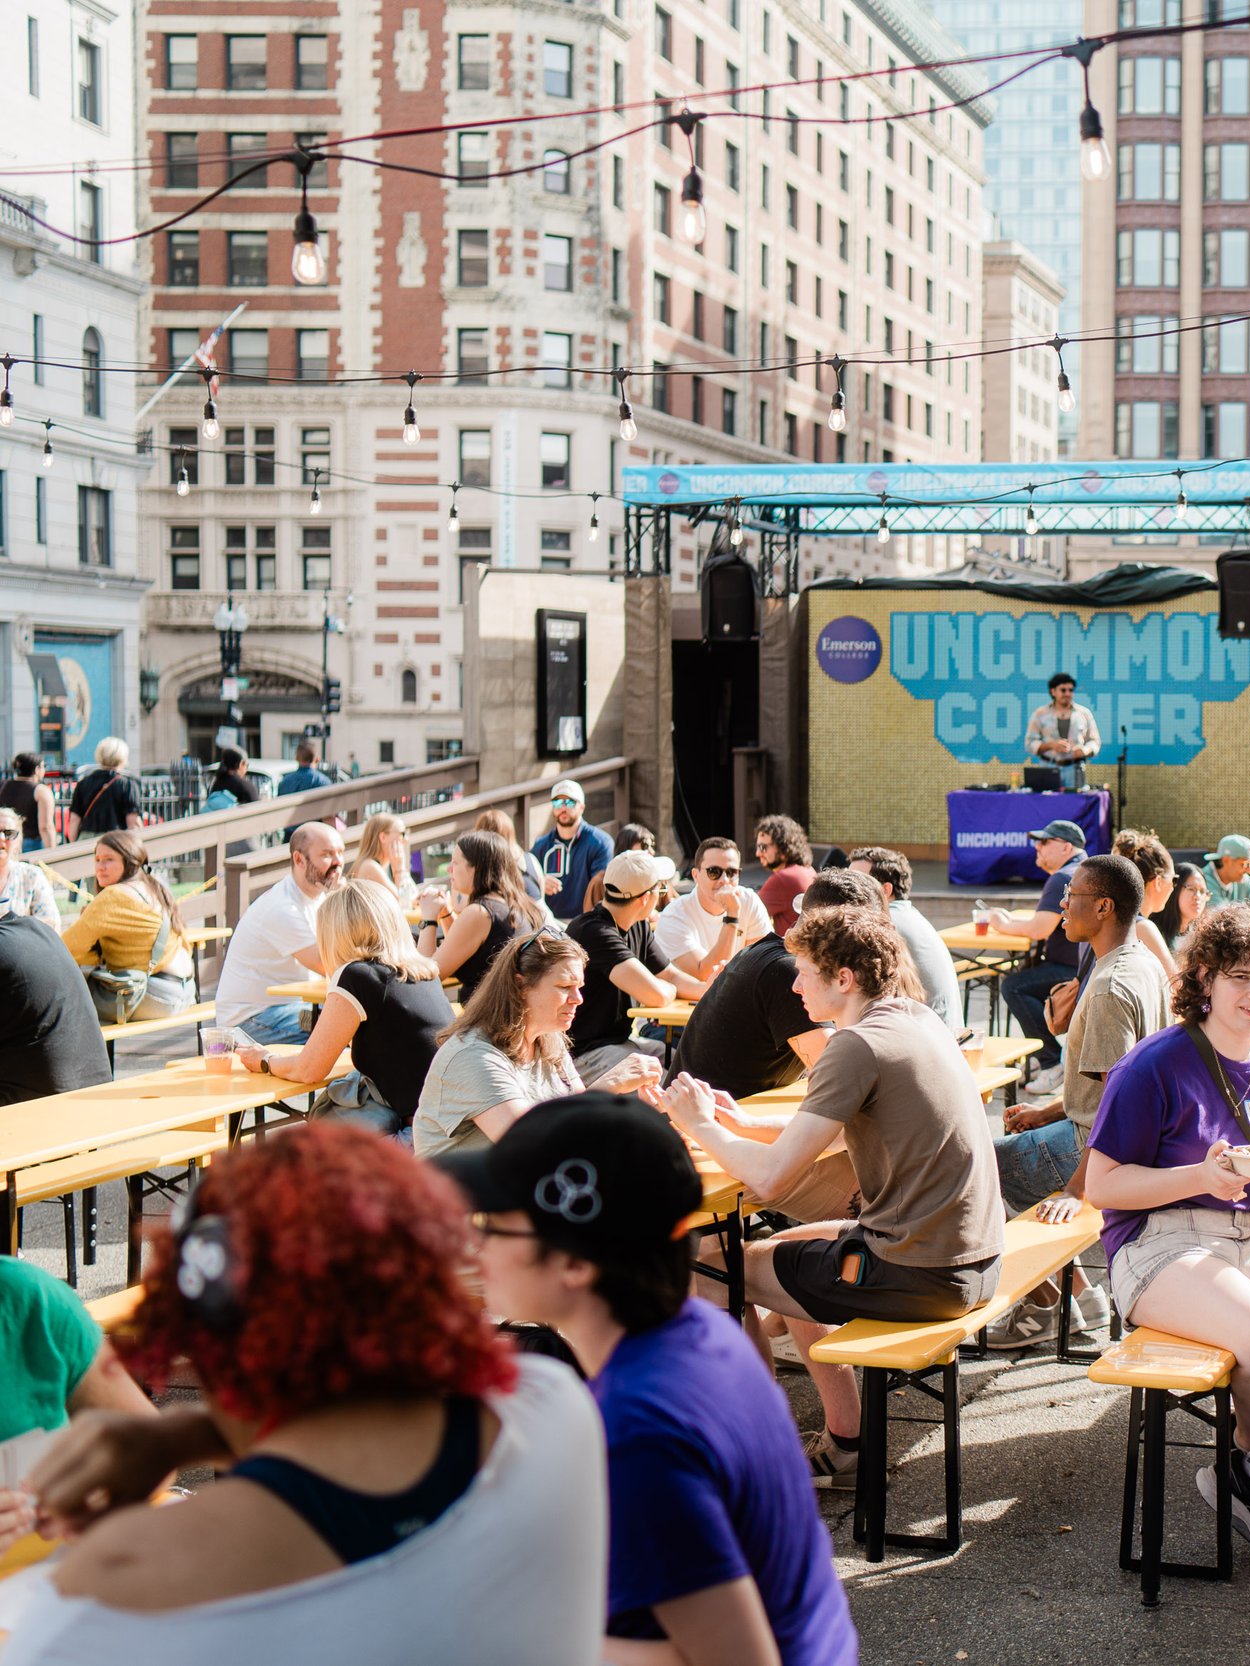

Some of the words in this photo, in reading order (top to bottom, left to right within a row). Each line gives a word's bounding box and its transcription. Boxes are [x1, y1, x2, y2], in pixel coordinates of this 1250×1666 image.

[822, 637, 876, 651] Emerson
[938, 692, 1204, 745] CONER
[957, 832, 1028, 848] UNCOMMON
